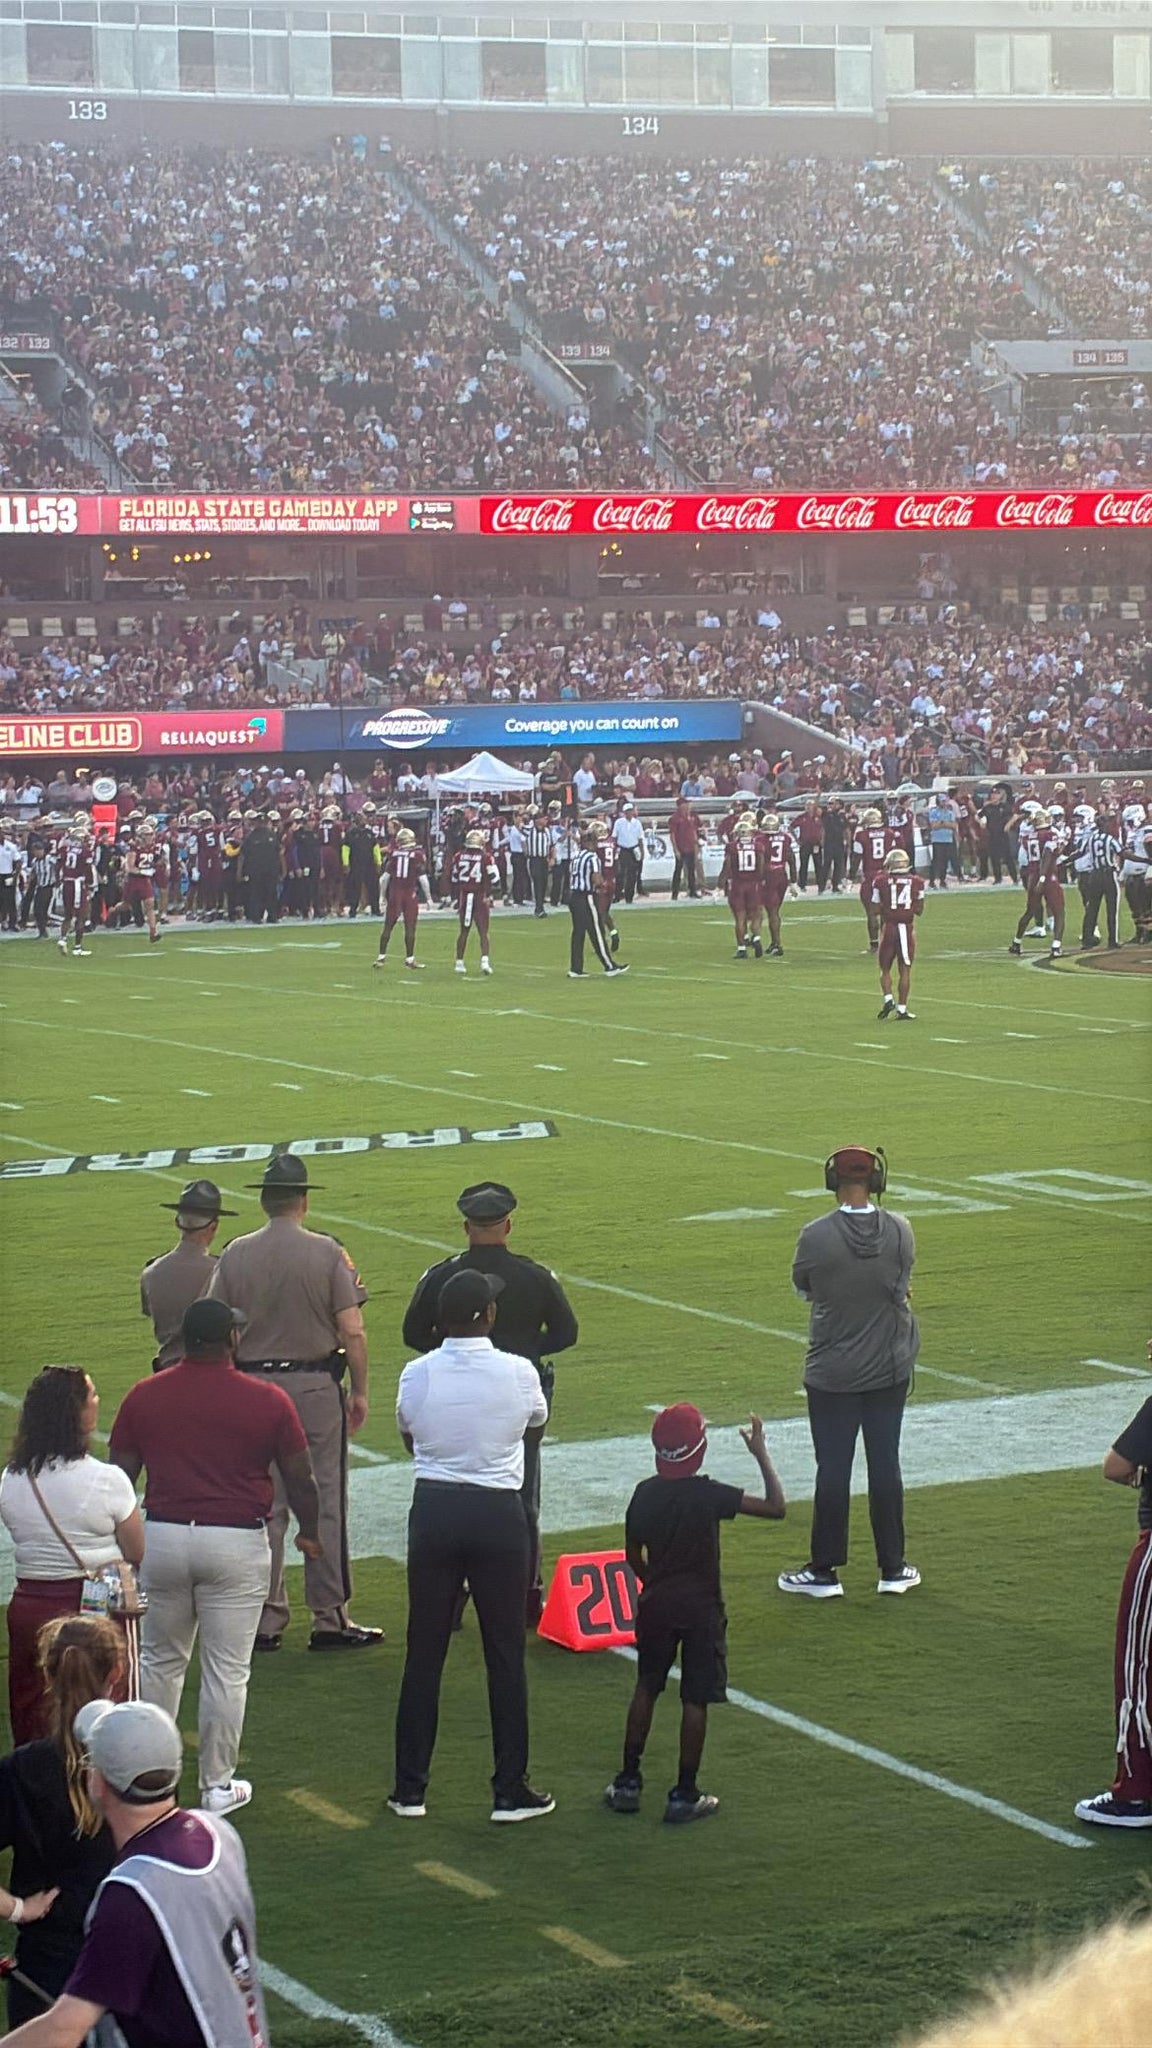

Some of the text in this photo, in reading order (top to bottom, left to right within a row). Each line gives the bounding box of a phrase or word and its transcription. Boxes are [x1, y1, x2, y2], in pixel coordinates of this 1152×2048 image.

[69, 100, 107, 120] 133
[622, 116, 659, 135] 134
[0, 337, 50, 349] 32 133
[561, 345, 610, 357] 133 134
[1078, 351, 1125, 364] 134 135
[0, 497, 78, 533] 11:53
[119, 499, 398, 518] FLORIDA STATE GAMEDAY APP
[491, 498, 576, 531] Coca-Cola
[593, 498, 677, 531] Coca-Cola
[696, 497, 779, 530] Coca-Cola
[797, 496, 879, 529] Coca-Cola
[894, 495, 977, 528] Coca-Cola
[996, 494, 1077, 526] Coca-Cola
[119, 519, 135, 532] GET
[136, 519, 151, 532] ALL
[152, 519, 167, 532] FSU
[259, 518, 276, 531] AND
[307, 518, 351, 531] DOWNLOAD
[69, 723, 133, 747] CLUB
[362, 719, 451, 736] PROGRESSIVE
[505, 716, 679, 735] Coverage you can count on
[161, 729, 260, 746] RELIAQUEST
[205, 832, 216, 847] 5
[872, 838, 884, 859] 8
[604, 848, 614, 867] 9
[738, 850, 756, 871] 10
[770, 842, 783, 862] 3
[396, 856, 410, 878] 11
[459, 861, 482, 883] 24
[890, 884, 912, 909] 14
[570, 1560, 638, 1636] 20
